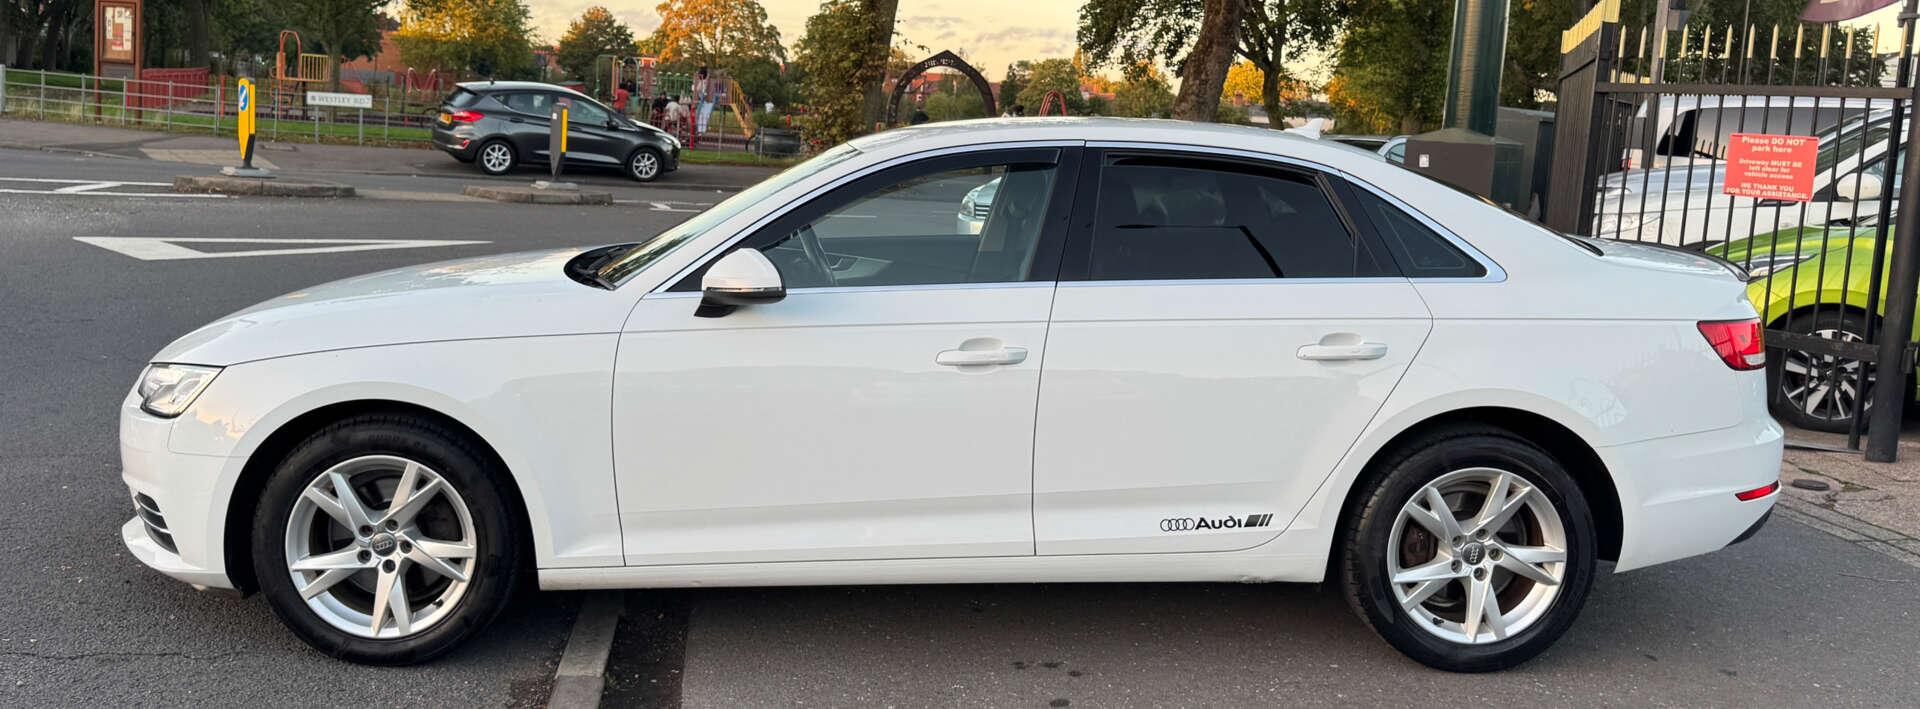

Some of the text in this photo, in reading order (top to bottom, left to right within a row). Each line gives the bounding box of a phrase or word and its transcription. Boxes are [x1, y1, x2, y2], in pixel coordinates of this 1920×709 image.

[1742, 136, 1806, 146] Please DO NOT
[1751, 145, 1770, 153] park
[1738, 158, 1769, 166] Driveway
[1742, 188, 1761, 196] YOUR
[1195, 516, 1242, 530] Audi
